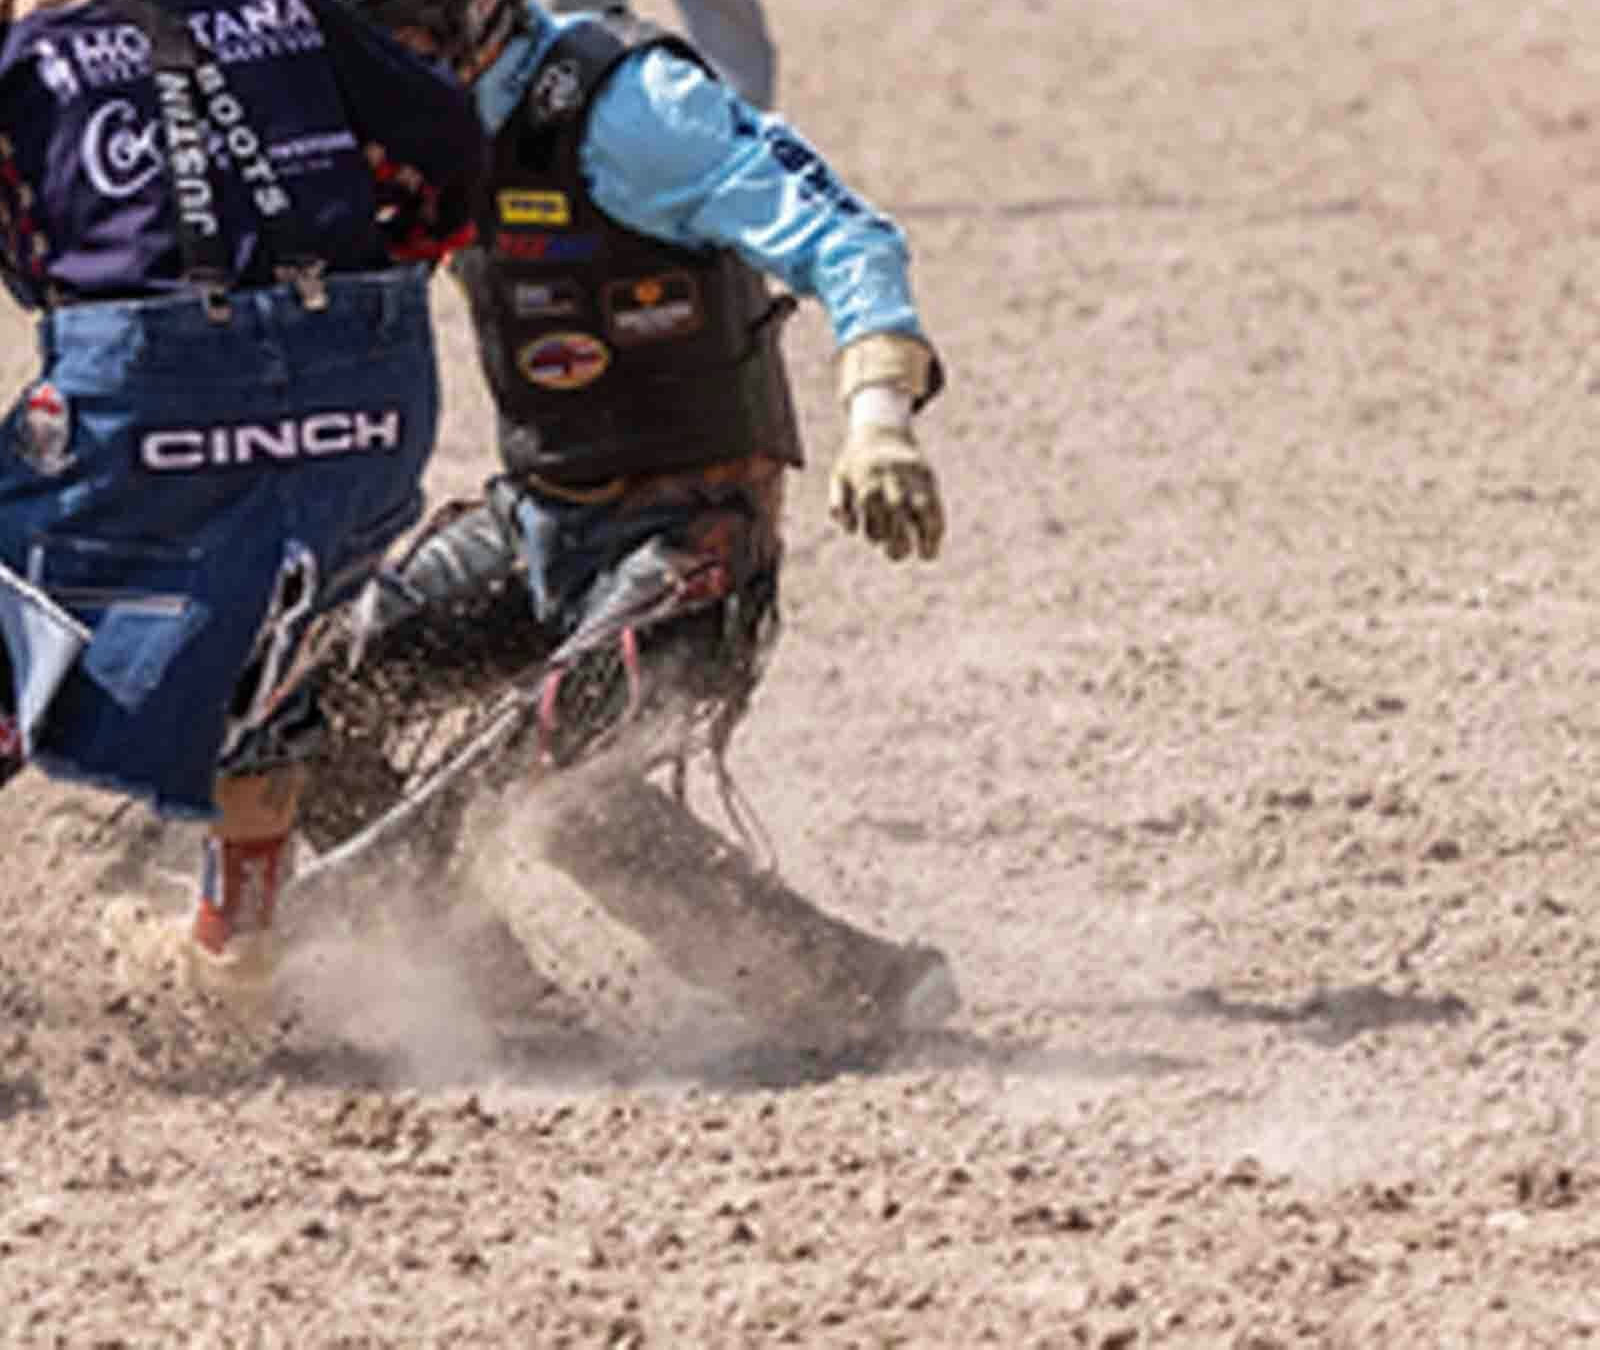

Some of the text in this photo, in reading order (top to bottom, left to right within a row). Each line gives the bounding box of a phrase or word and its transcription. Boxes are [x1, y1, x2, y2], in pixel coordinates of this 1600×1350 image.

[154, 70, 218, 238] JUSTIN
[196, 62, 290, 216] BOOTS
[142, 408, 400, 470] CINCH
